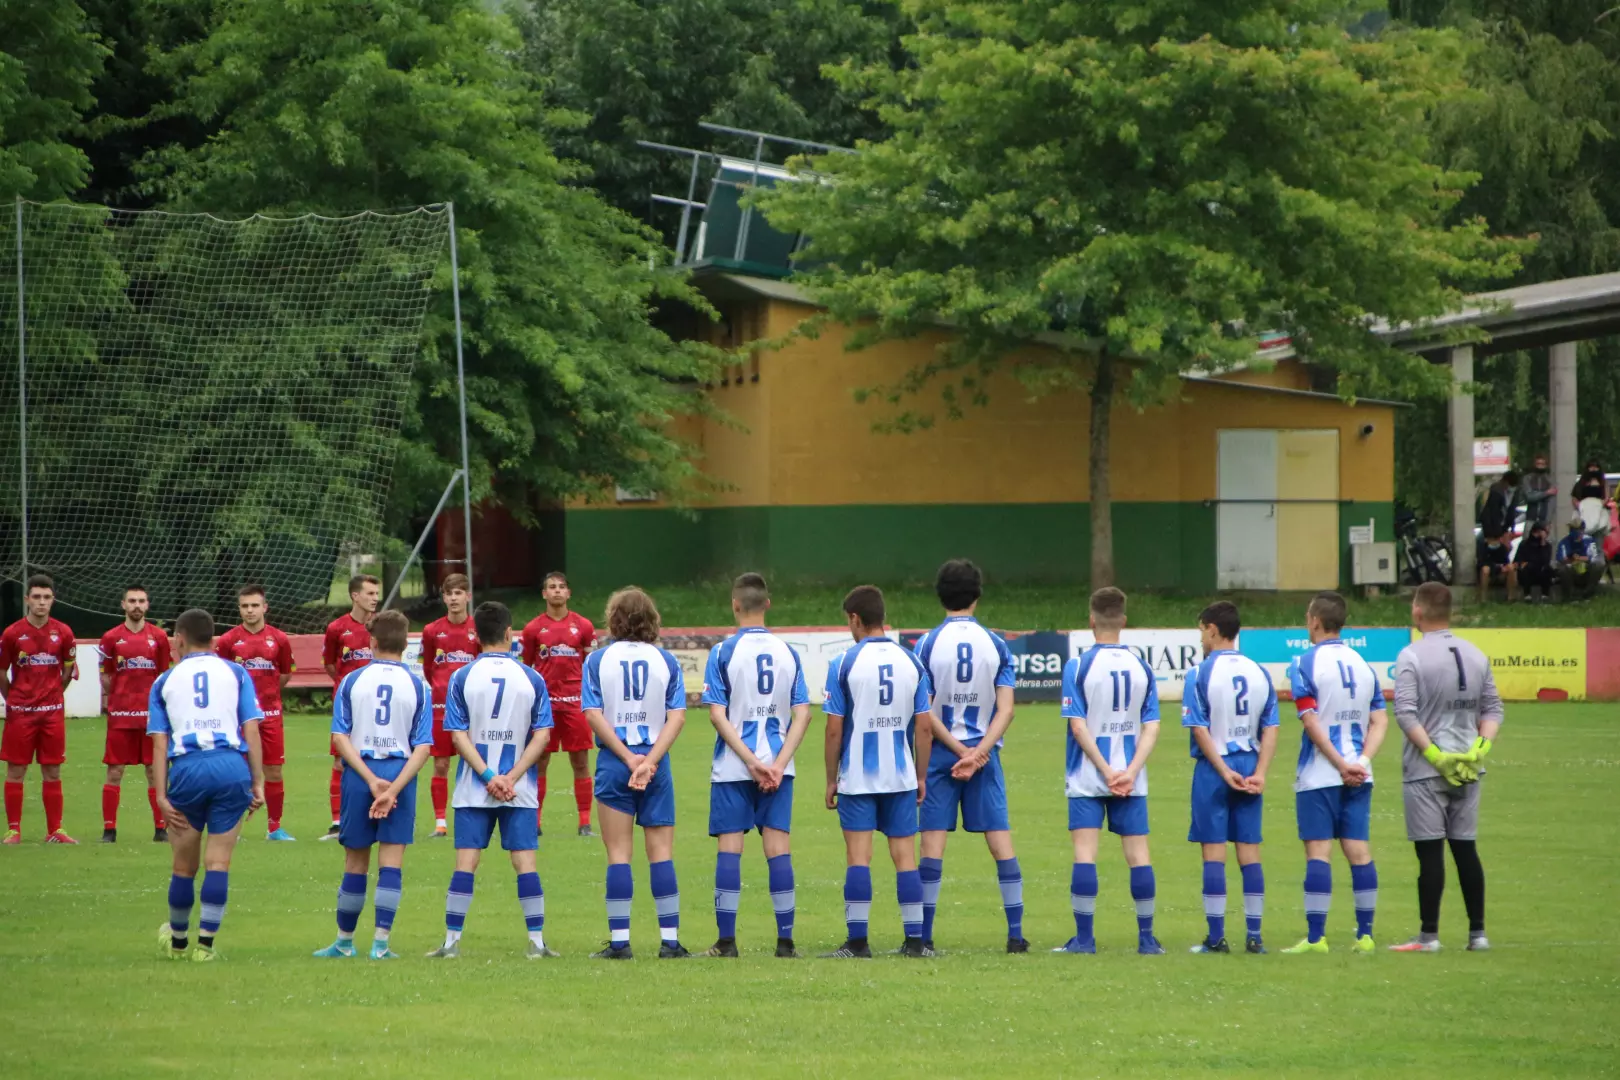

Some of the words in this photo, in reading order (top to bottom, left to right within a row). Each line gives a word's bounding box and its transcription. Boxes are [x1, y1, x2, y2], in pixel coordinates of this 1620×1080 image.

[619, 659, 649, 701] 10
[756, 653, 775, 695] 6
[957, 642, 973, 683] 8
[1337, 660, 1357, 699] 4
[1448, 647, 1467, 691] 1
[193, 671, 209, 709] 9
[375, 684, 393, 726] 3
[491, 678, 506, 719] 7
[878, 664, 894, 706] 5
[1110, 670, 1131, 711] 11
[1232, 675, 1249, 716] 2
[373, 736, 398, 748] REINOA
